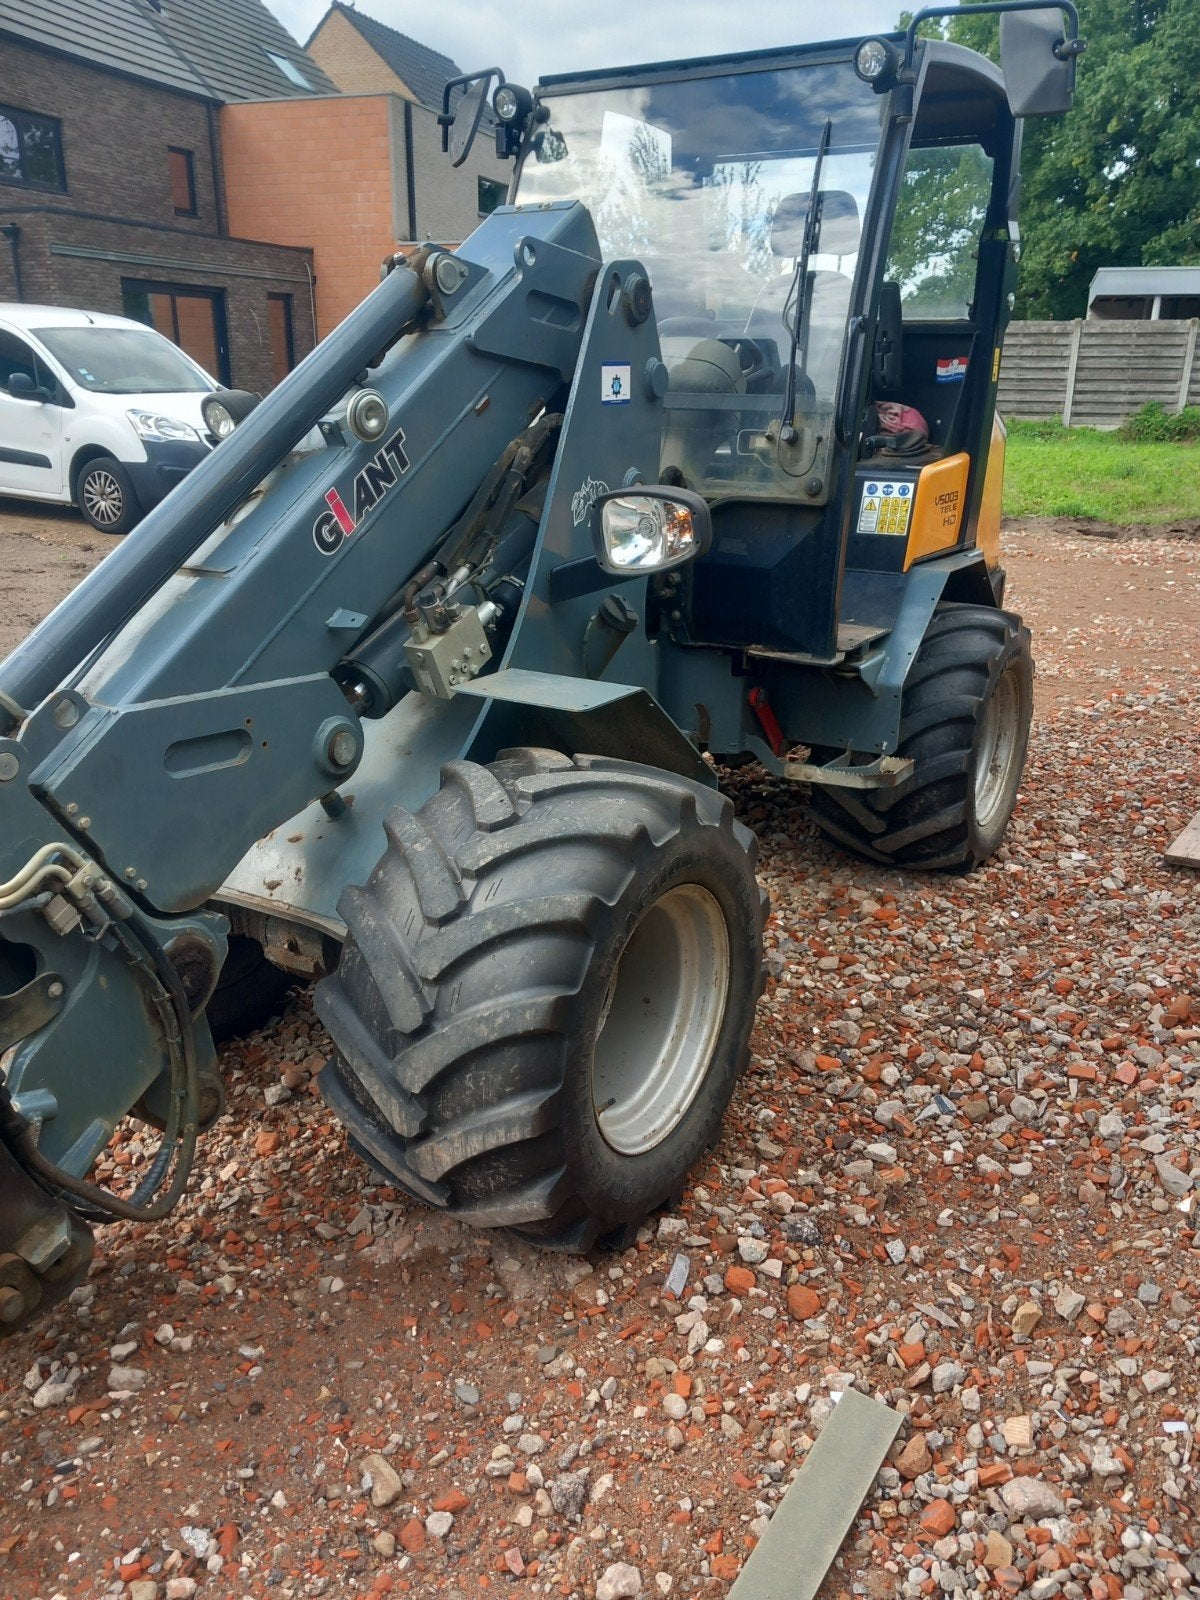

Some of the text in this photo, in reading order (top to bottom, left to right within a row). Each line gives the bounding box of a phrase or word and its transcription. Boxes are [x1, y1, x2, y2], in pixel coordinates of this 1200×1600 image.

[934, 490, 959, 507] V5003
[940, 503, 957, 514] TELE
[943, 514, 957, 527] HD
